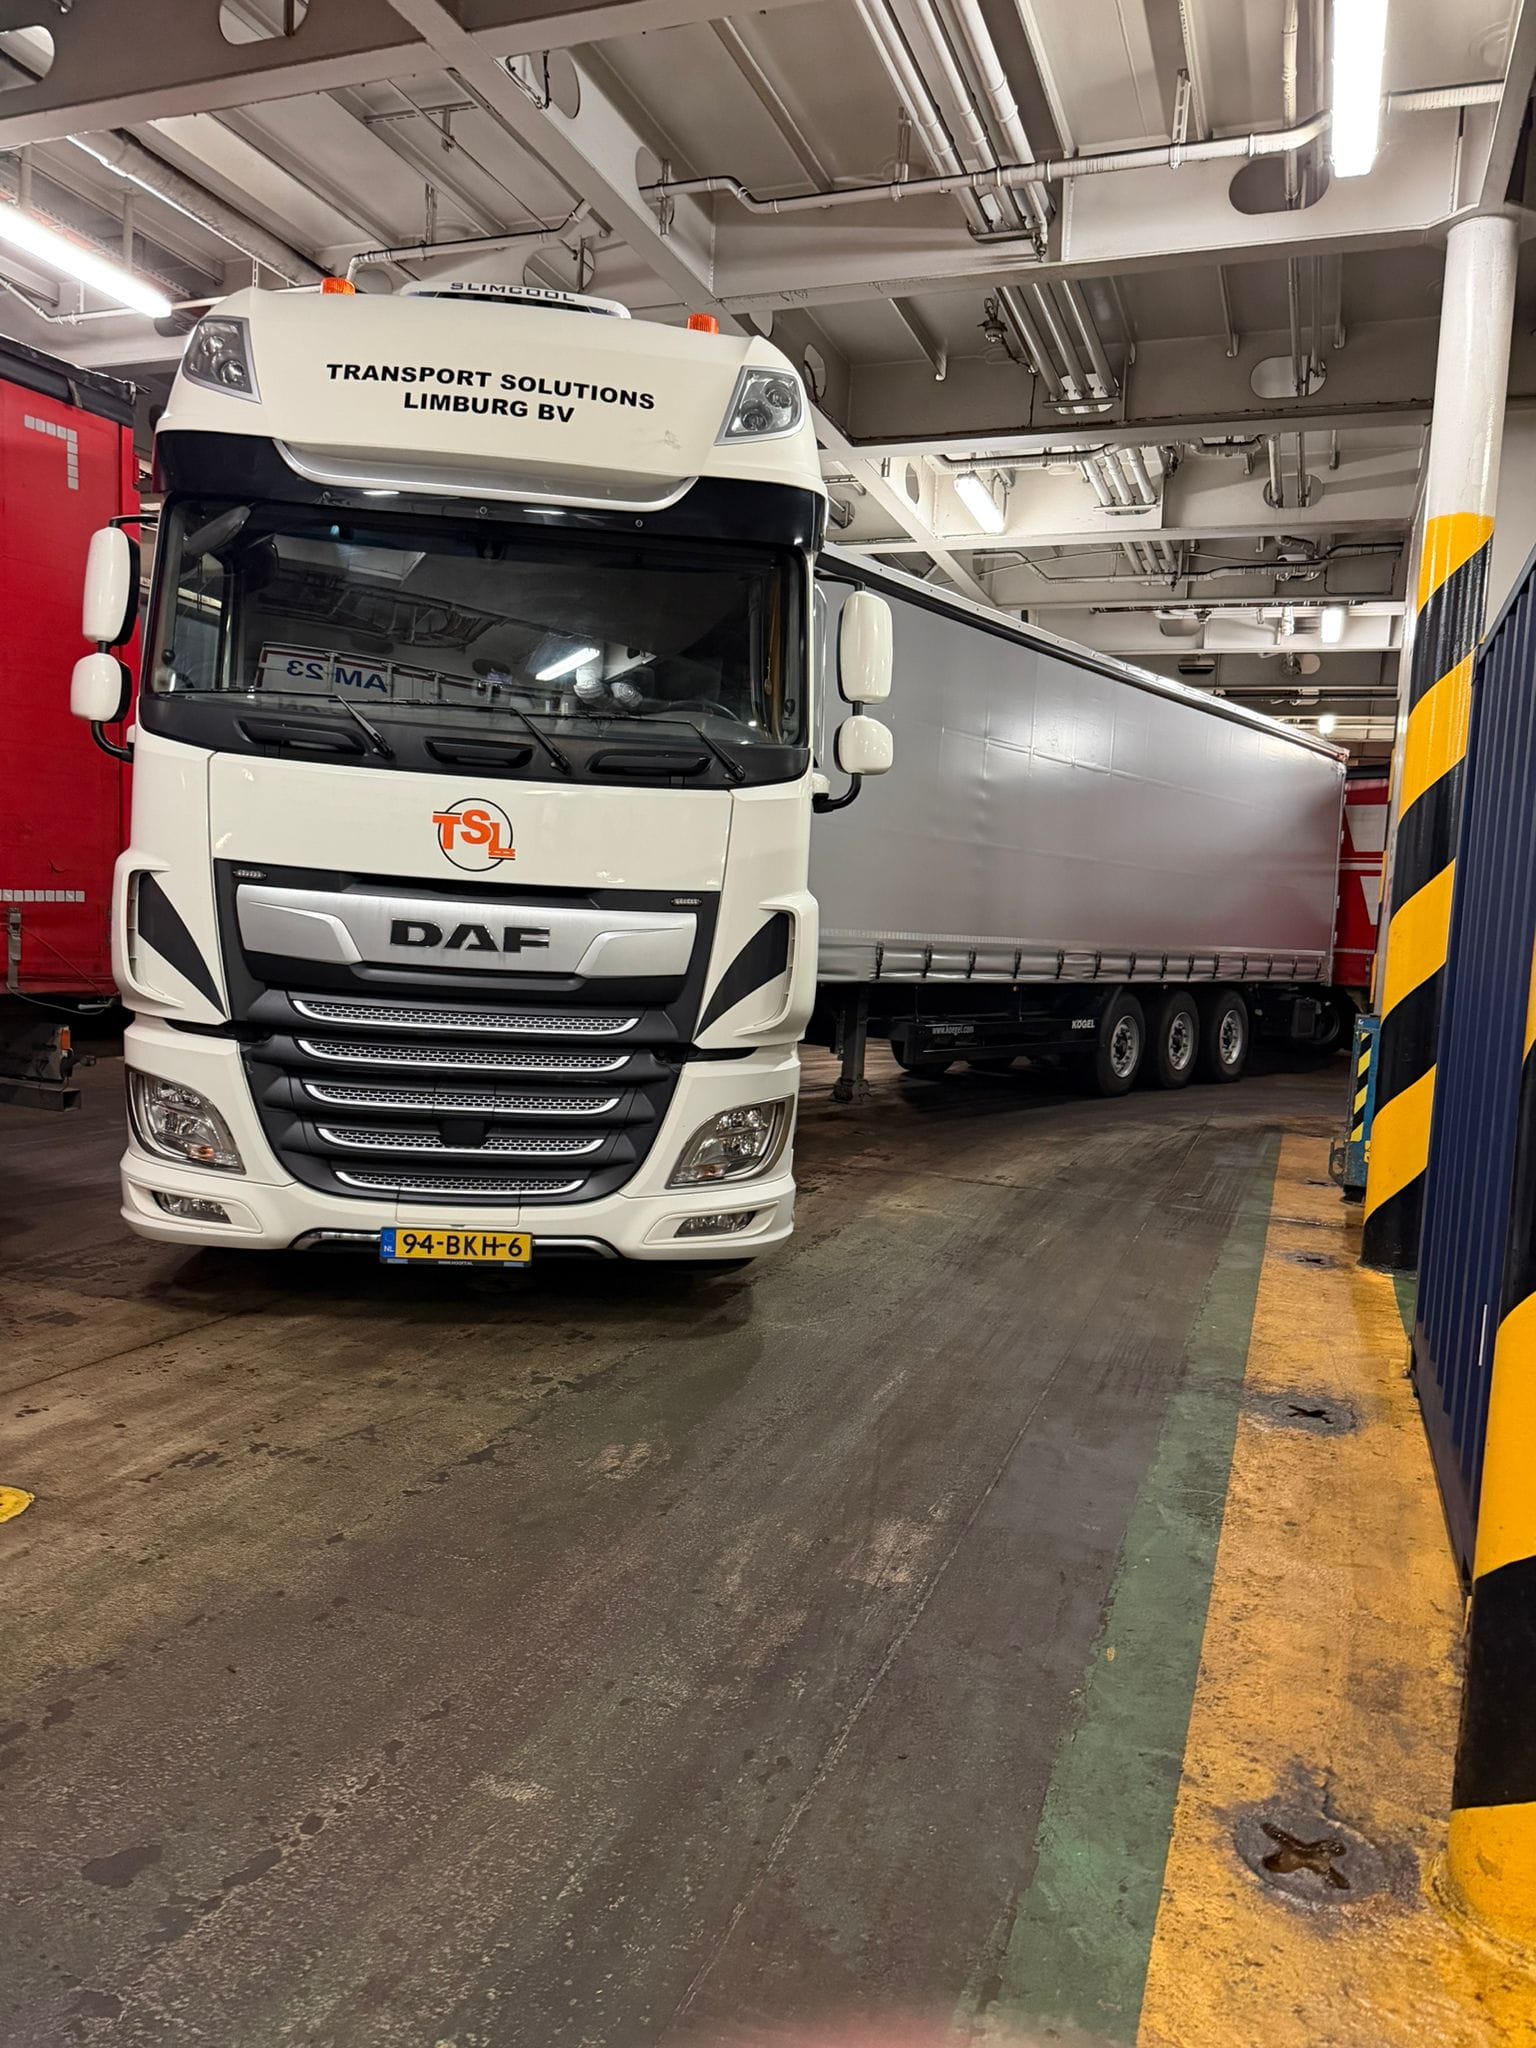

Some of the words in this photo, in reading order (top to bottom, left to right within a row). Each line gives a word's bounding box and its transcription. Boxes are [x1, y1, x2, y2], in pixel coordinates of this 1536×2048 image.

[450, 282, 576, 302] SLIMCOOL
[326, 363, 492, 388] TRANSPORT
[500, 373, 655, 410] SOLUTIONS
[403, 392, 529, 418] LIMBURG
[537, 403, 575, 424] BV
[432, 809, 516, 858] TSL
[389, 917, 551, 954] DAF
[383, 1244, 394, 1253] NL
[402, 1232, 523, 1258] 94-BKH-6
